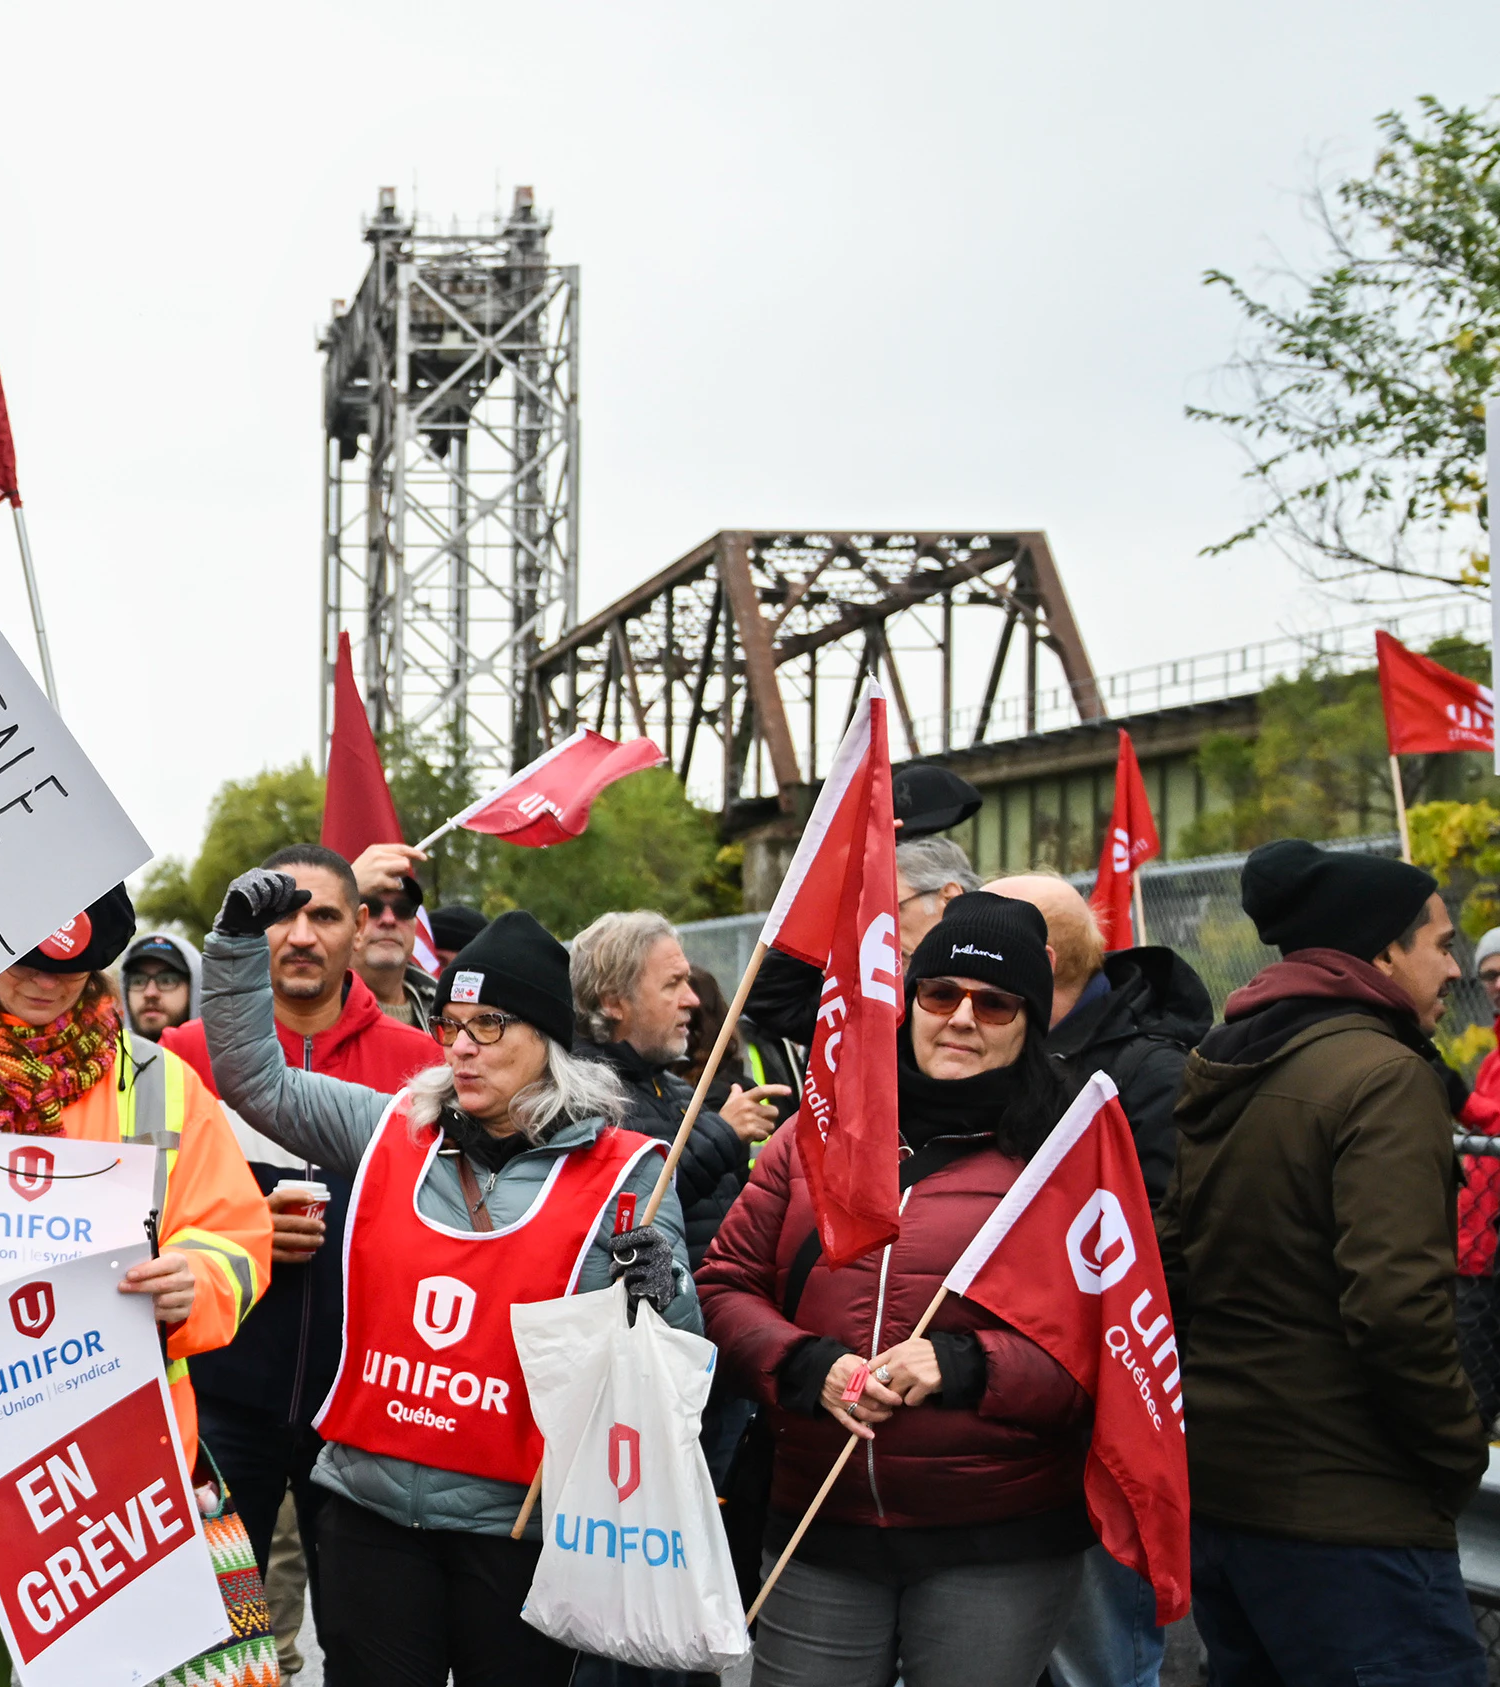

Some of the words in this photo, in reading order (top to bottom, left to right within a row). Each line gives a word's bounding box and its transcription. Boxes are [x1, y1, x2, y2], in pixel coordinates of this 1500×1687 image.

[387, 1400, 457, 1432] Québec
[1105, 1325, 1162, 1432] Québec
[15, 1441, 98, 1534] EN
[16, 1477, 184, 1634] GRÈVE
